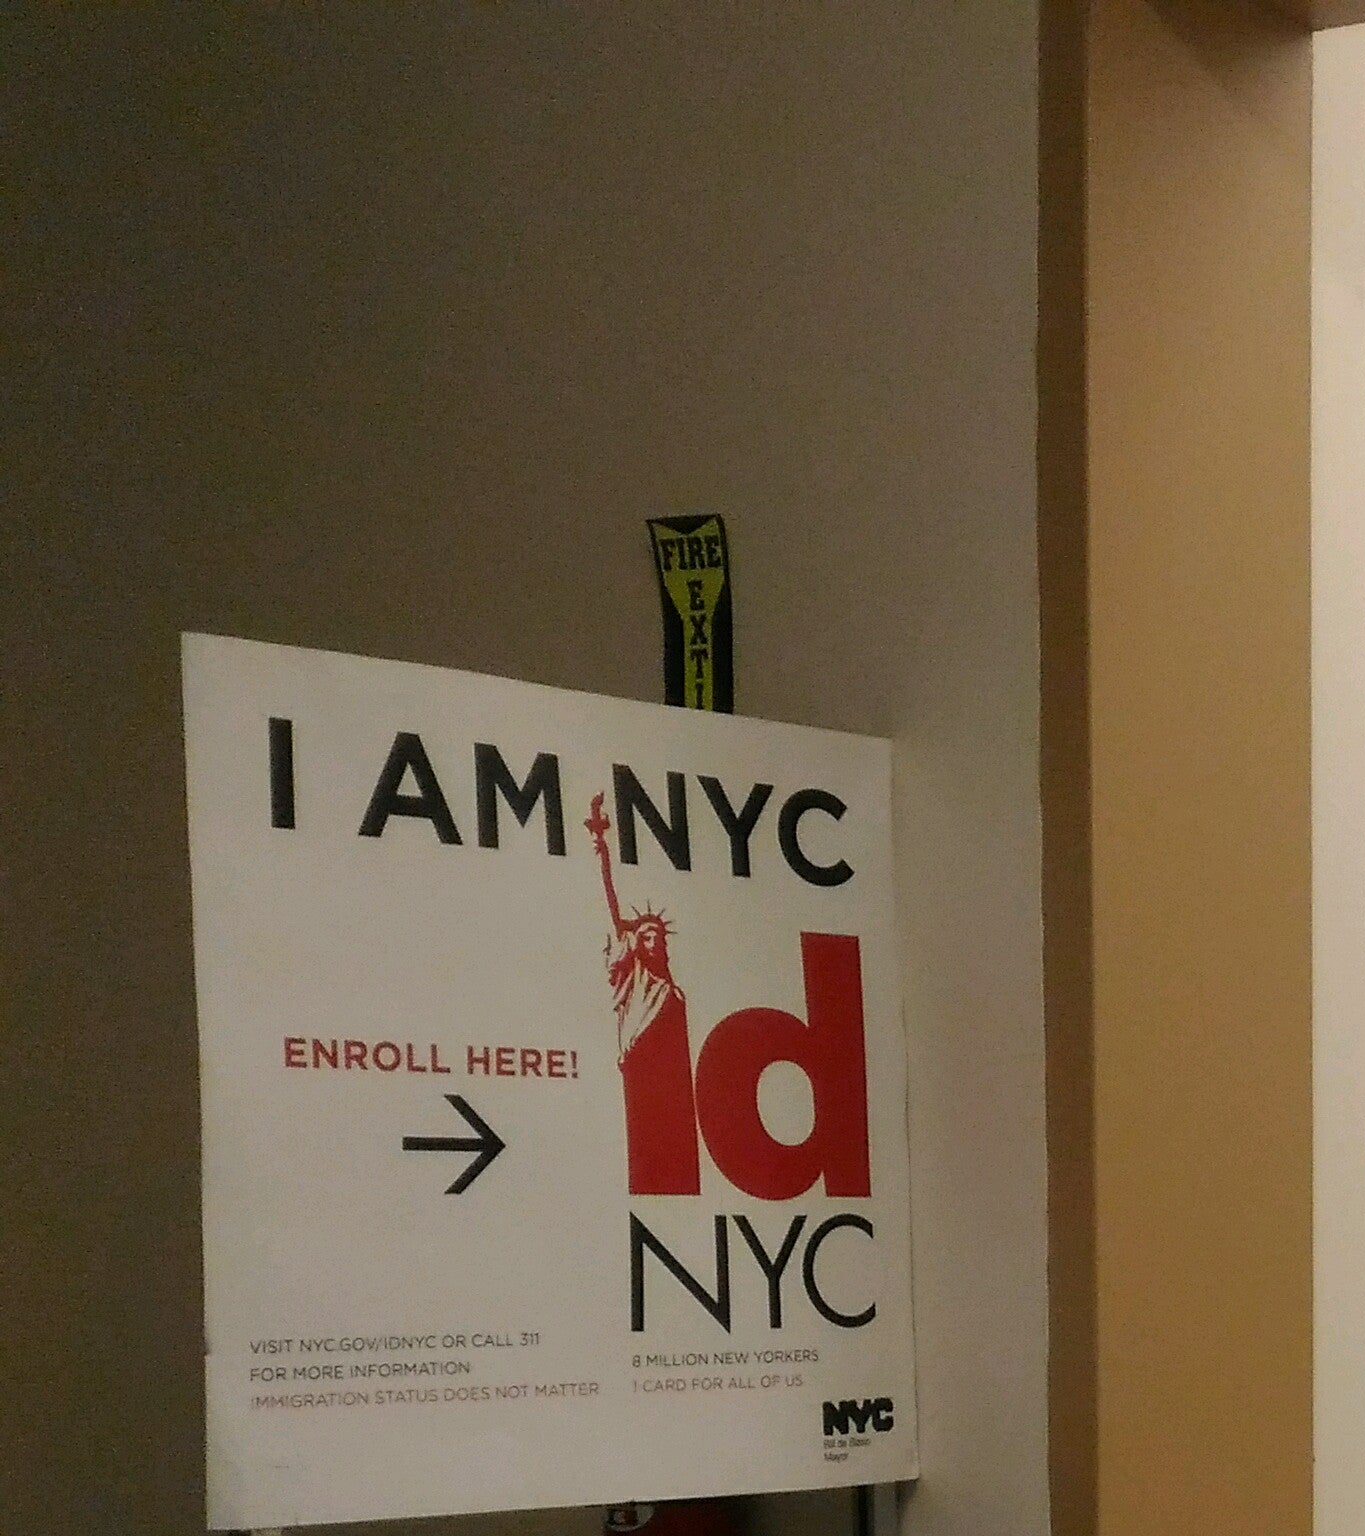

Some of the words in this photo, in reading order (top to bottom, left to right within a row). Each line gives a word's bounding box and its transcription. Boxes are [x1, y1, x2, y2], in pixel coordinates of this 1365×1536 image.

[659, 534, 722, 571] FIRE
[268, 717, 296, 829] I
[358, 731, 567, 857] AM
[612, 763, 856, 887] NYC
[284, 1036, 451, 1074] ENROLL
[467, 1045, 579, 1079] HERE!
[629, 1210, 877, 1335] NYC
[250, 1339, 293, 1354] VISIT
[442, 1335, 466, 1348] OR
[471, 1333, 513, 1348] CALL
[519, 1332, 541, 1346] 311
[250, 1367, 287, 1382] FOR
[293, 1364, 344, 1380] MORE
[350, 1361, 471, 1378] INFORMATION
[632, 1354, 641, 1368] 8
[646, 1353, 709, 1367] MILLION
[713, 1352, 749, 1365] NEW
[754, 1349, 820, 1364] YORKERS
[374, 1388, 438, 1405] STATUS
[444, 1385, 491, 1401] DOES
[495, 1384, 528, 1399] NOT
[534, 1381, 600, 1397] MATTER
[642, 1377, 687, 1393] CARD
[691, 1377, 723, 1391] FOR
[728, 1375, 756, 1389] ALL
[760, 1374, 782, 1388] OF
[785, 1374, 804, 1387] US
[822, 1397, 894, 1436] NYC
